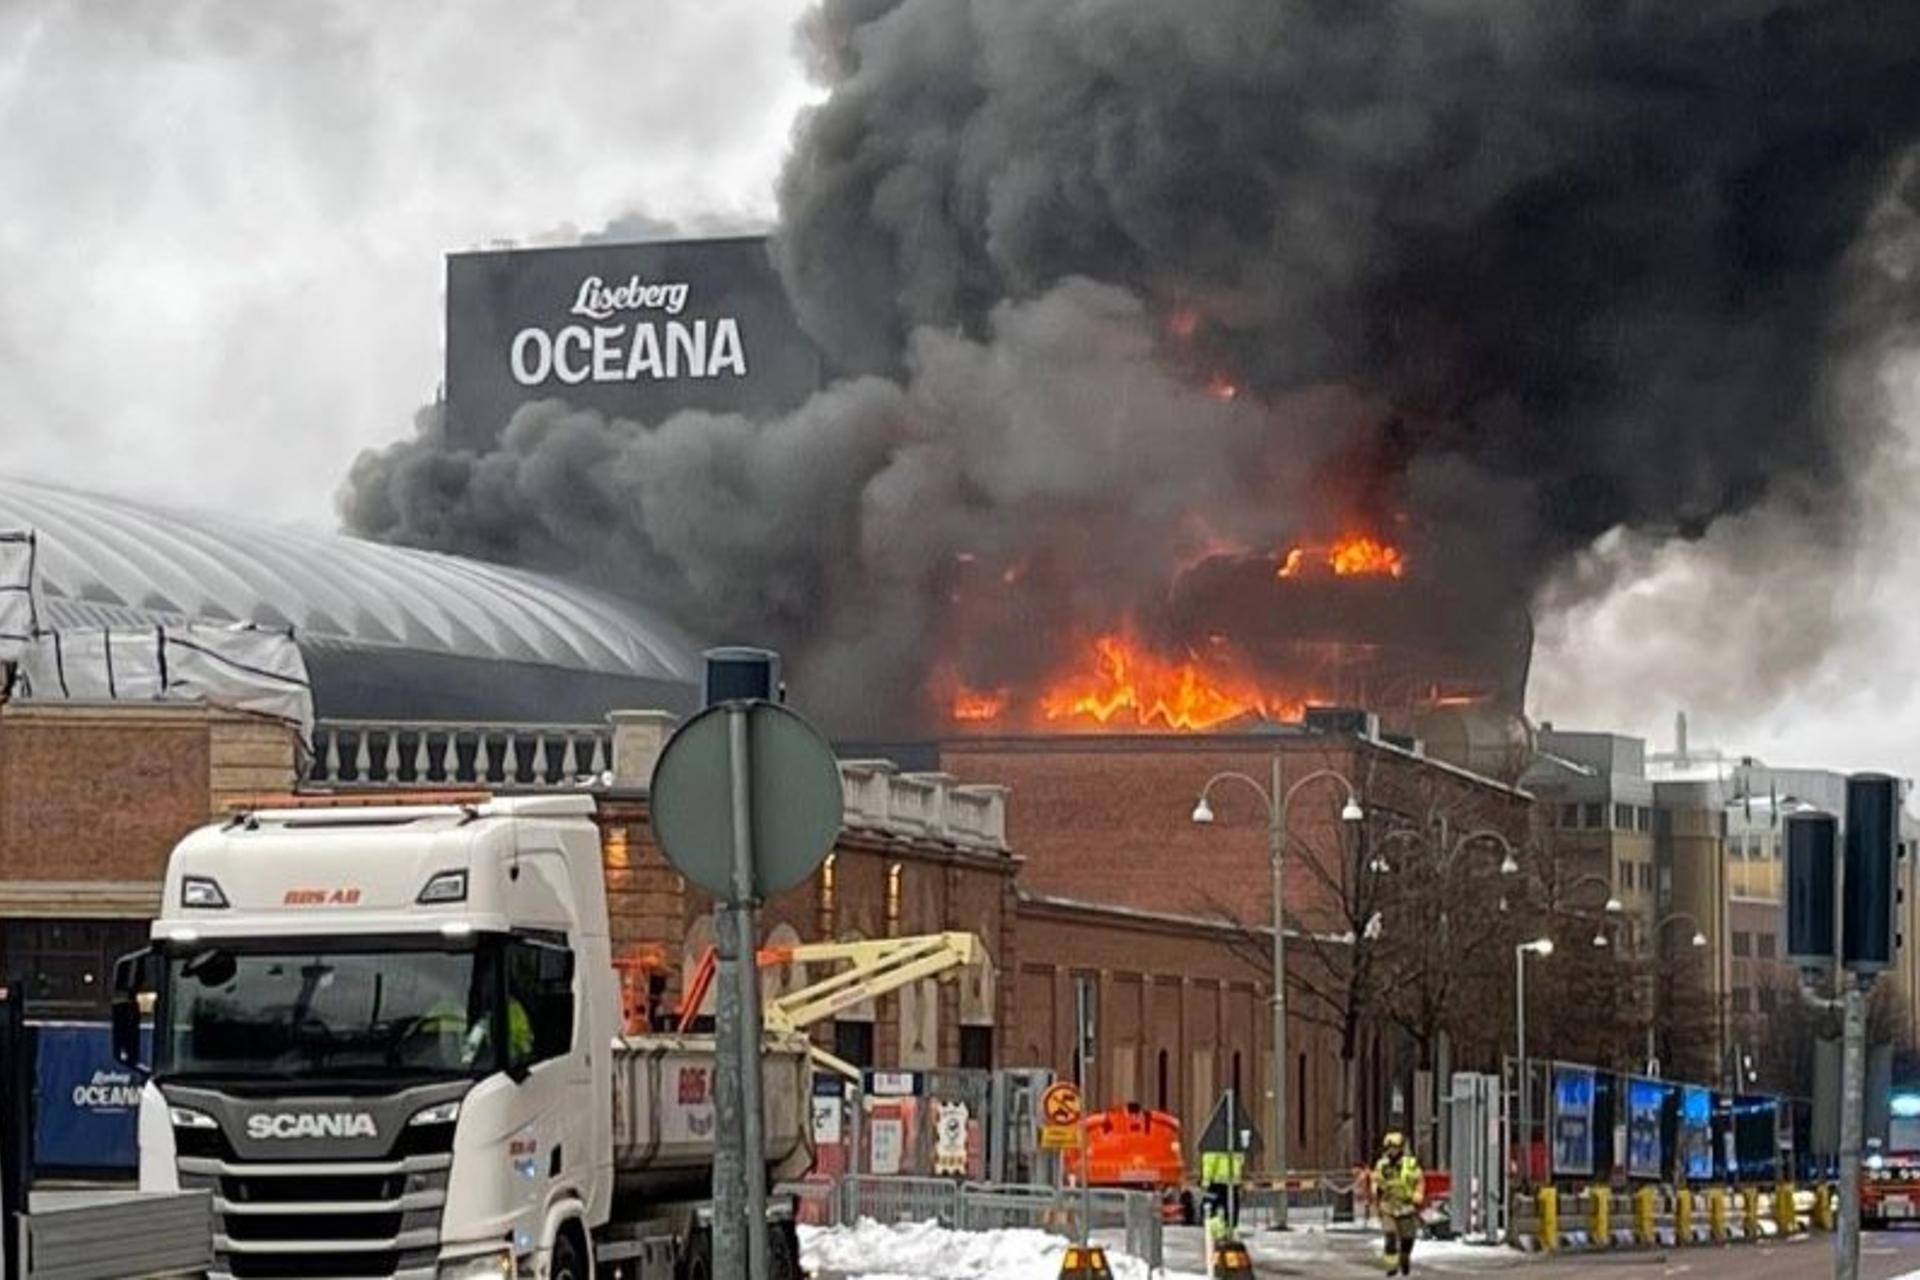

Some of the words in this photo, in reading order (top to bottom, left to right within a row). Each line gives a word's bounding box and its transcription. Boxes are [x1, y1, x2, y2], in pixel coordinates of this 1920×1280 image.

[570, 275, 689, 319] Liseberg
[511, 318, 747, 385] OCEANA
[247, 1113, 377, 1138] SCANIA
